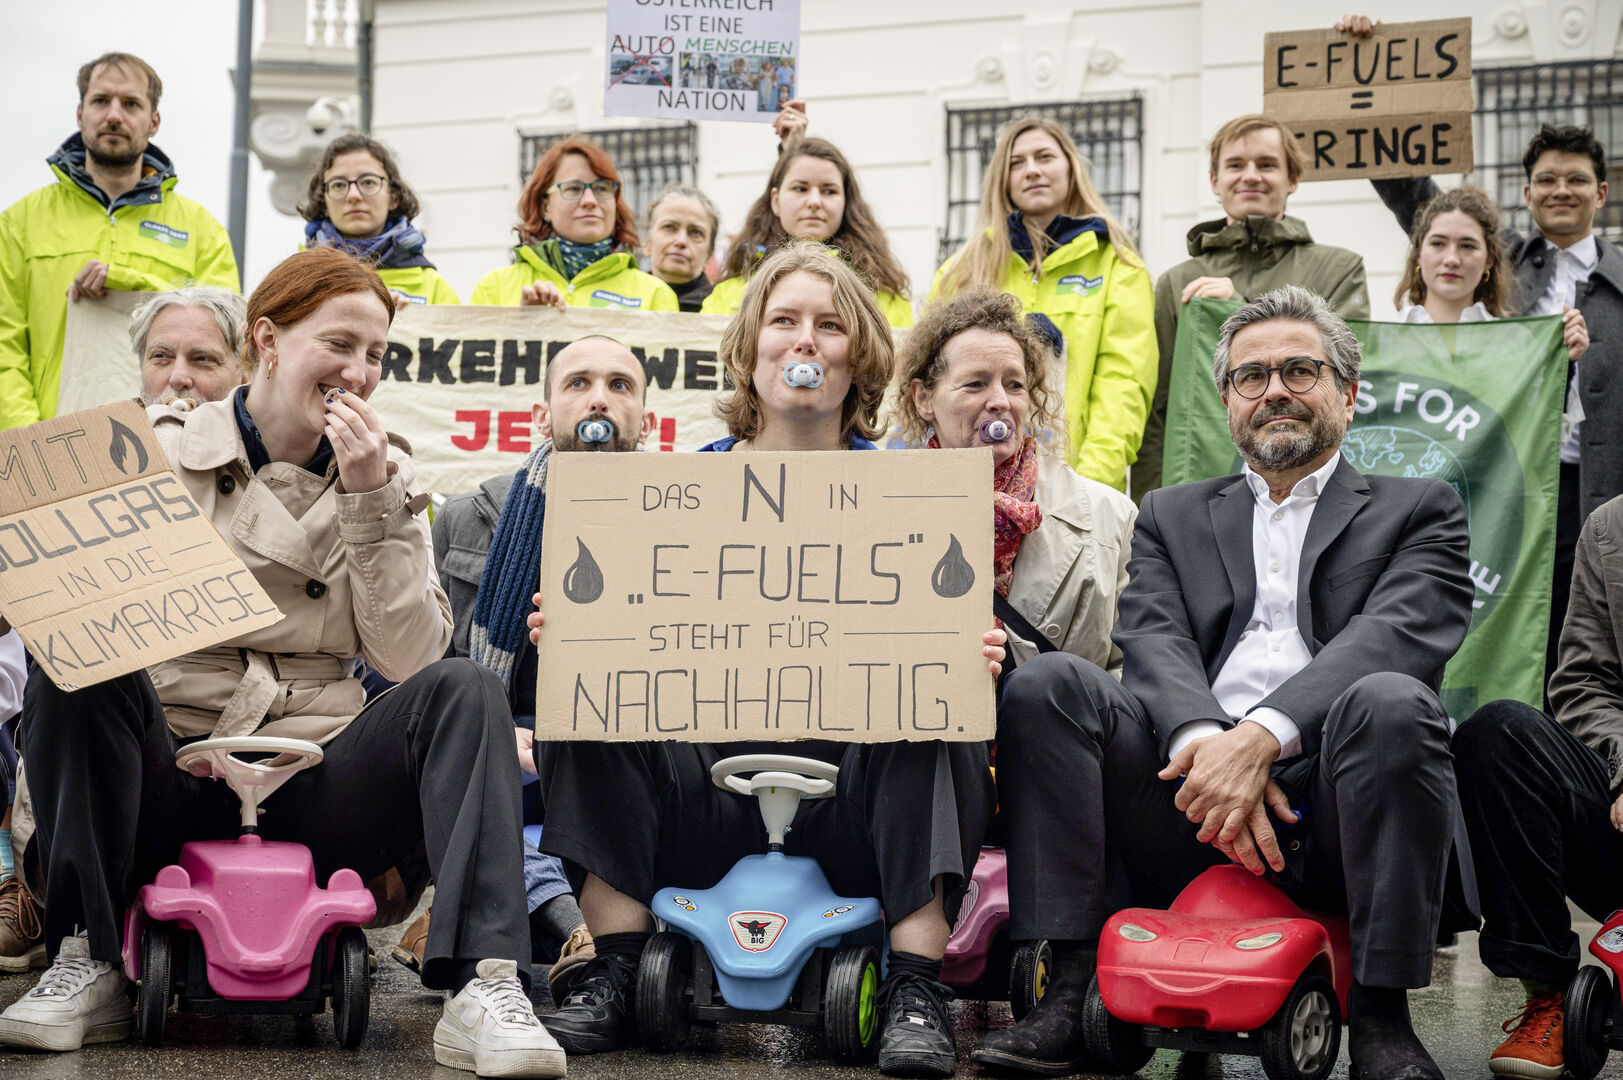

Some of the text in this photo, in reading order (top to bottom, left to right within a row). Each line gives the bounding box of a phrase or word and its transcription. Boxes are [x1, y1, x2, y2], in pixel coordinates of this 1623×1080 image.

[610, 35, 793, 55] AUTO MENSCHEN
[664, 14, 744, 34] IST EINE
[1277, 33, 1459, 88] E-FUELS
[657, 90, 746, 111] NATION
[1393, 381, 1481, 442] FOR
[642, 462, 858, 523] DAS N IN
[57, 545, 169, 599] IN DIE
[33, 569, 277, 676] KLIMAKRISE
[649, 615, 829, 652] STEHT FÜR
[572, 662, 965, 733] NACHHALTIG.
